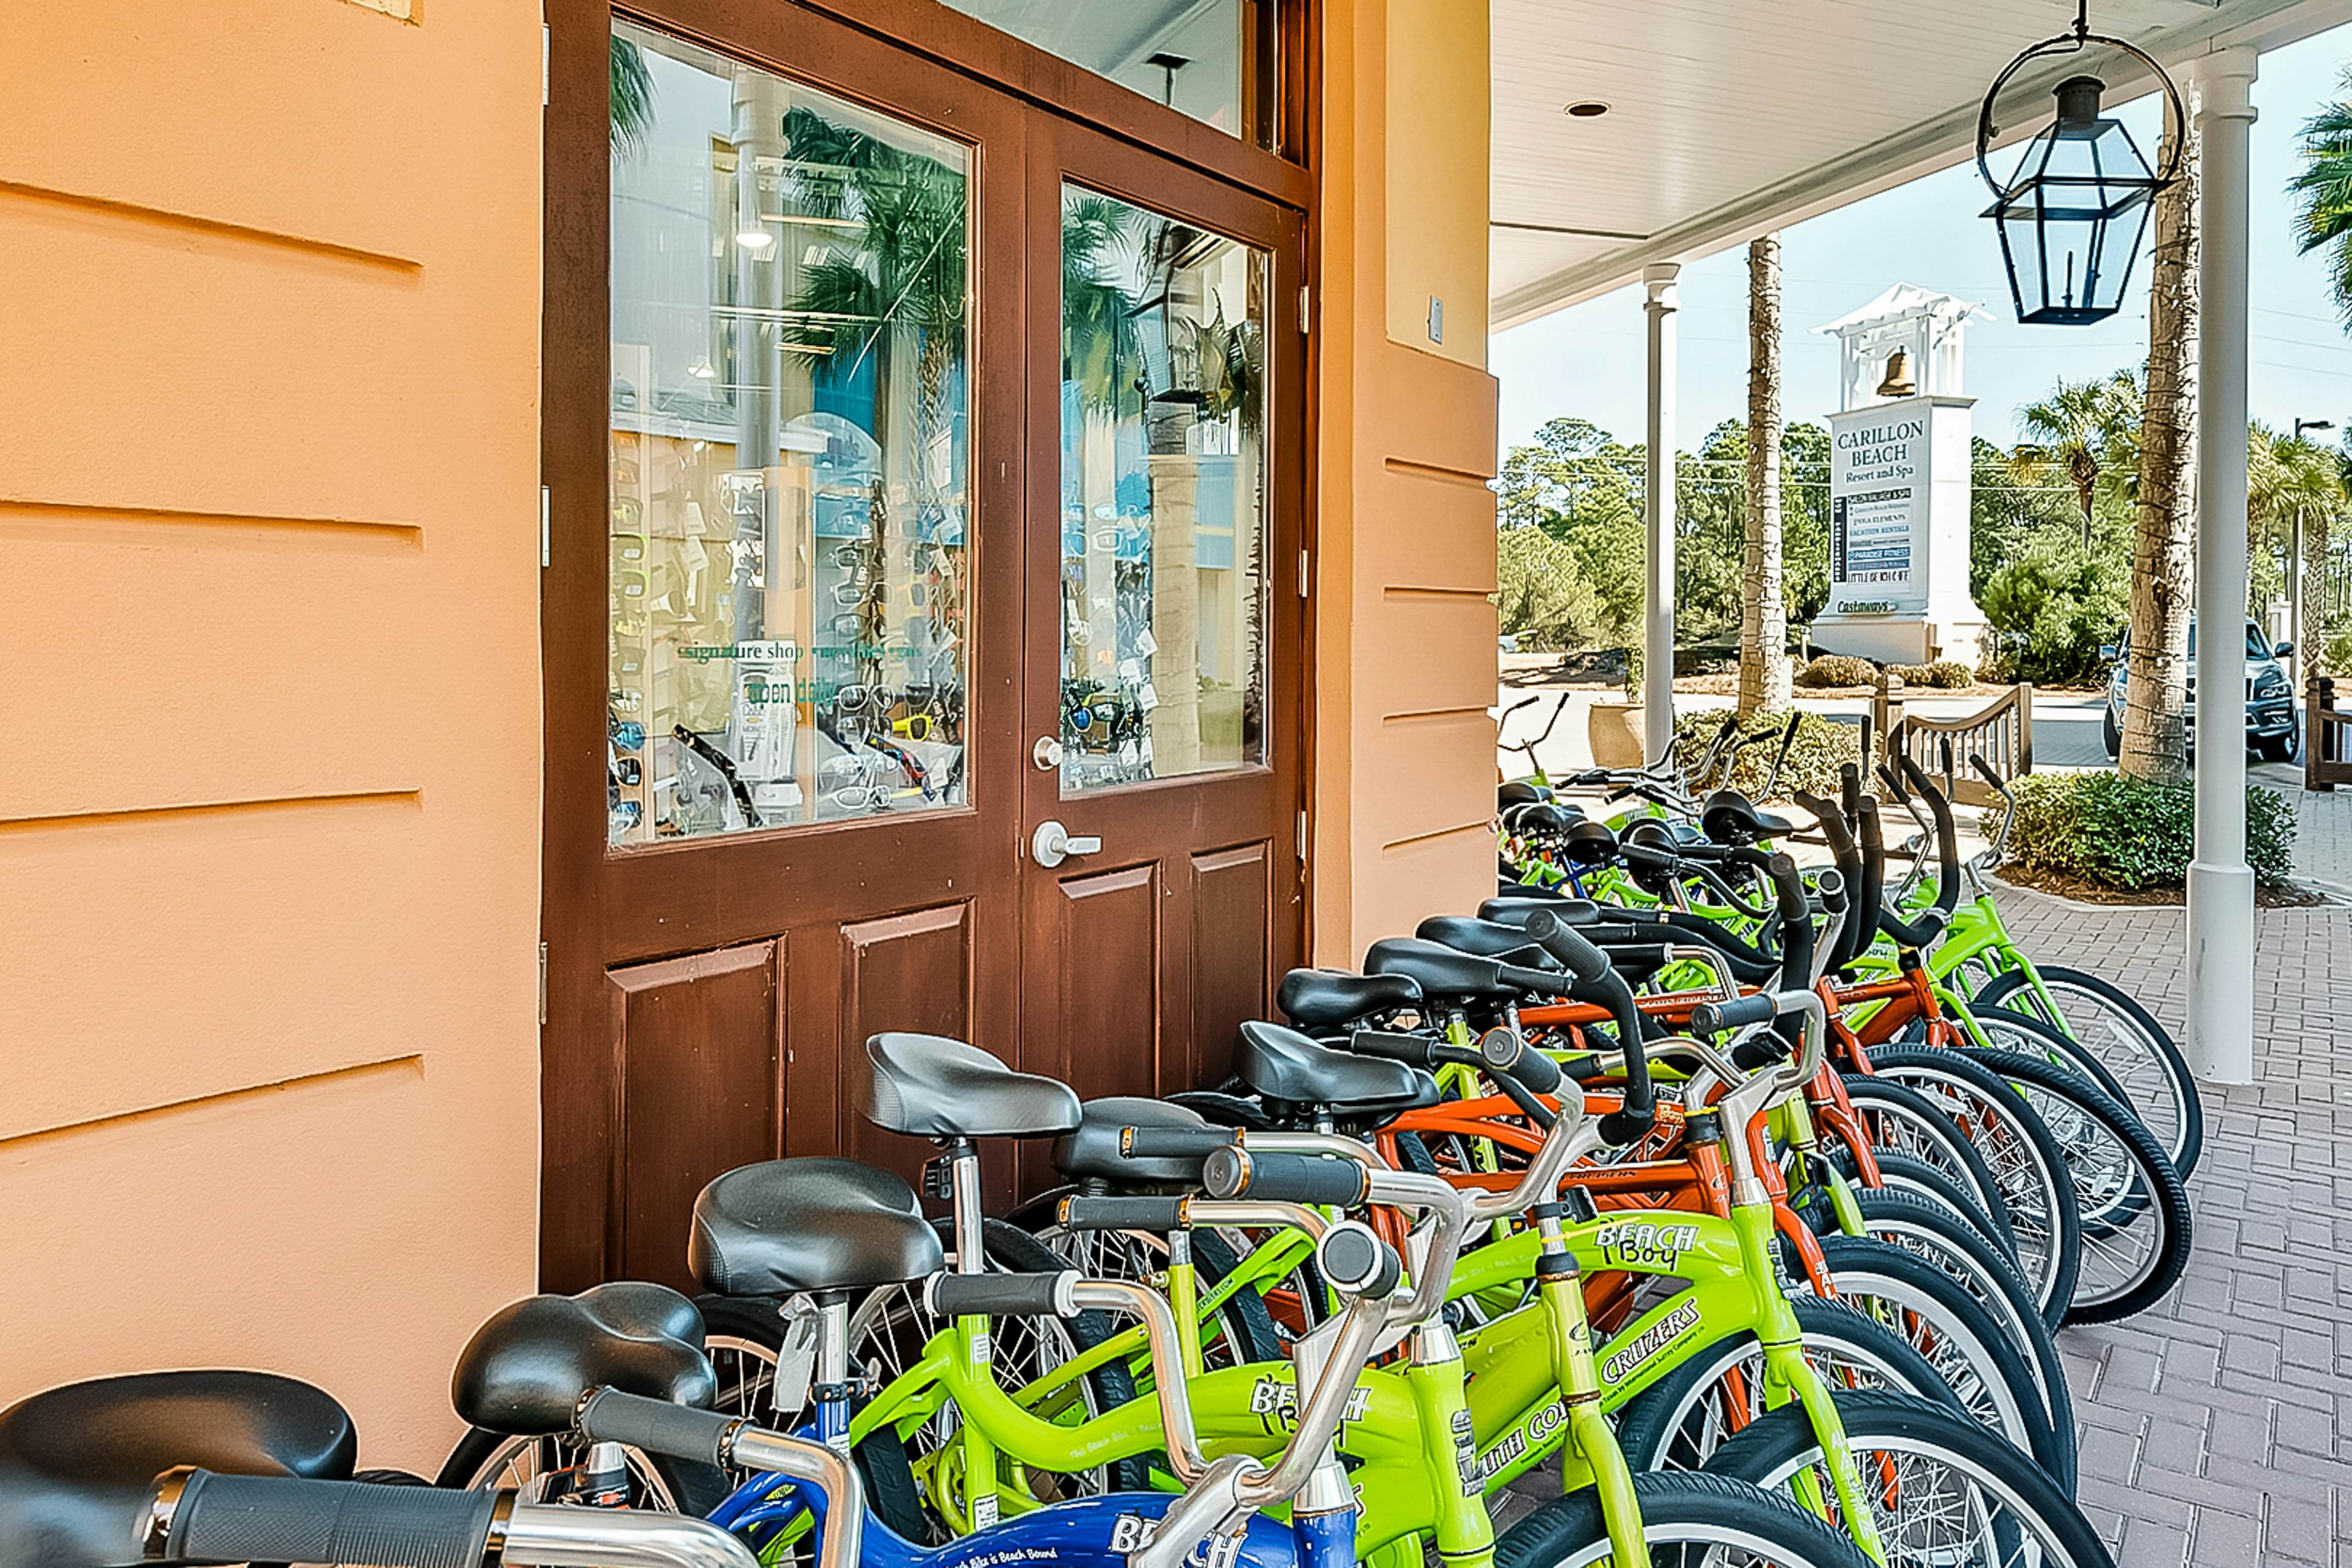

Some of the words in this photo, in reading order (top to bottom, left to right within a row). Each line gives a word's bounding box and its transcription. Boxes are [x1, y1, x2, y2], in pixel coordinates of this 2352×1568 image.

[1837, 420, 1923, 449] CARILLON
[1852, 444, 1907, 467] BEACH
[1846, 471, 1874, 483] Resort
[1876, 465, 1894, 478] and
[1895, 465, 1914, 479] Spa
[767, 641, 803, 664] shop
[749, 682, 790, 710] open
[1595, 1223, 1698, 1252] BEACH
[1620, 1240, 1677, 1272] Boy
[1601, 1297, 1699, 1384] CRUZERS
[1249, 1379, 1373, 1422] BEH
[1480, 1428, 1527, 1477] UTH
[989, 1553, 998, 1565] is
[998, 1548, 1026, 1563] Beach
[1026, 1547, 1058, 1560] Bound
